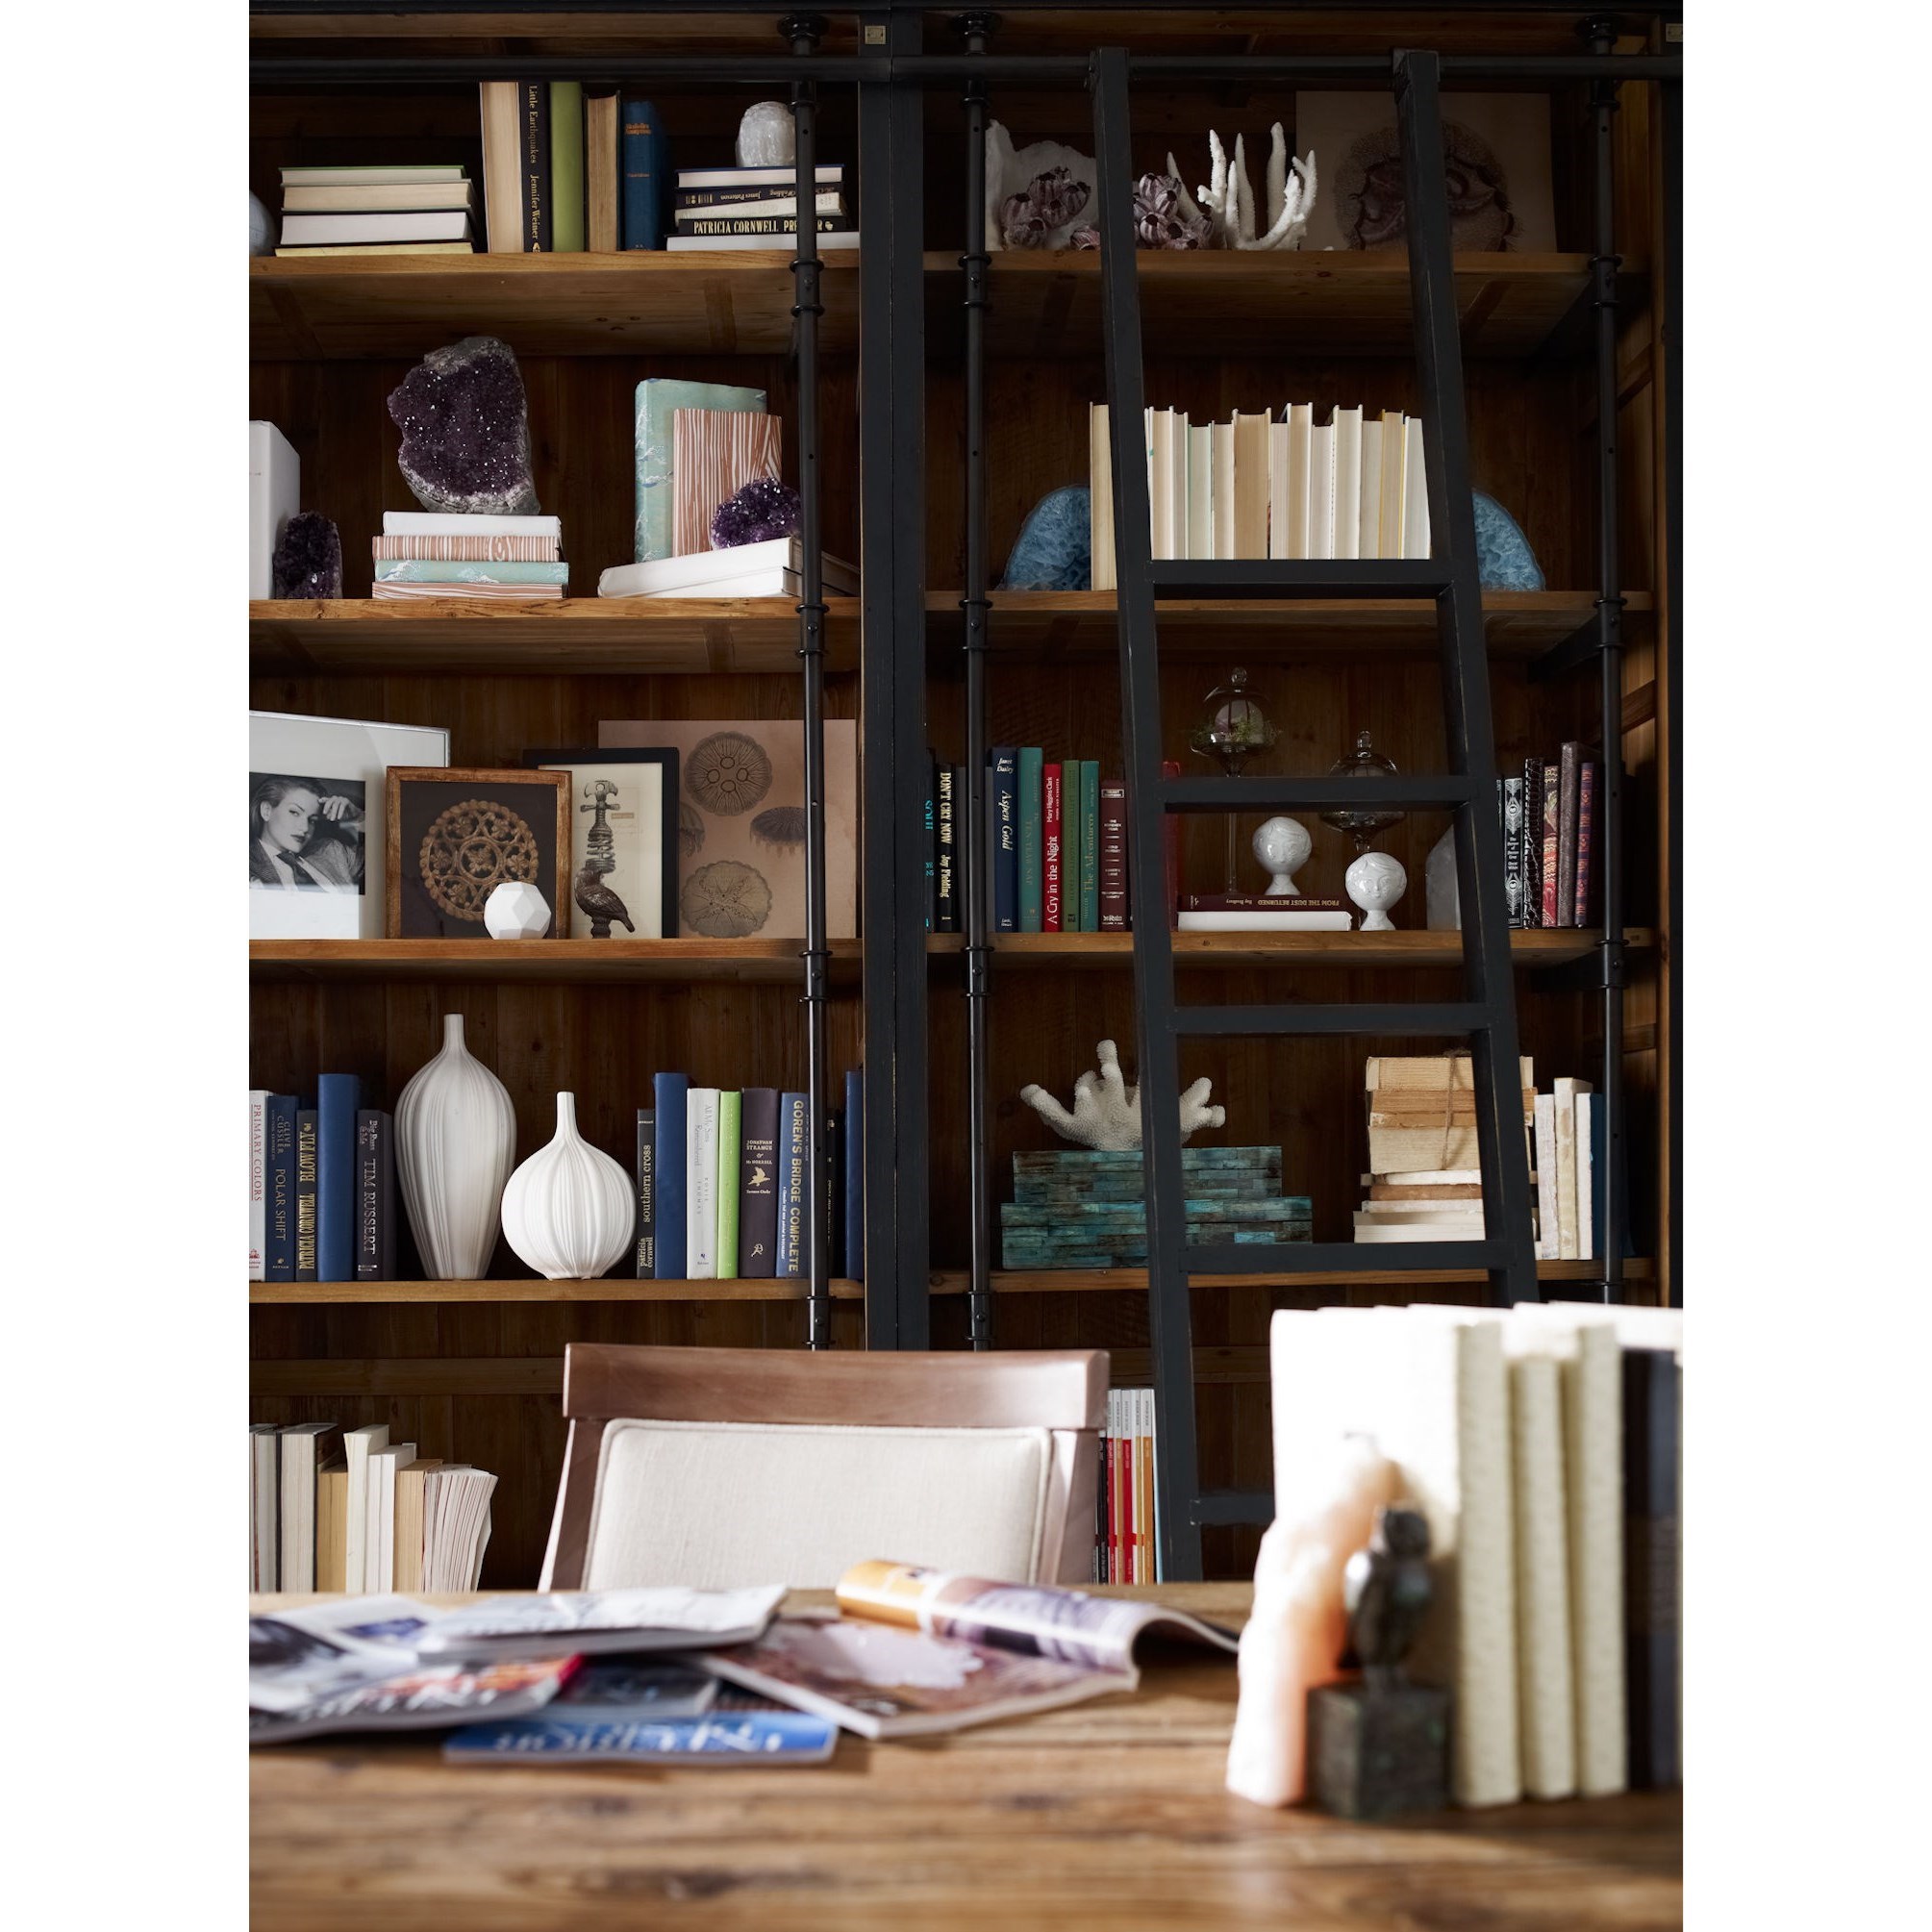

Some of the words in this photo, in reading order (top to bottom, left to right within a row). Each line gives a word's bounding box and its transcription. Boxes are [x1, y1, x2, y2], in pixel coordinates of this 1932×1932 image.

[528, 85, 539, 109] Little
[528, 111, 540, 163] Earthquakes
[530, 174, 541, 210] Jennifer
[720, 193, 745, 202] Patterson
[745, 190, 762, 200] James
[531, 210, 542, 239] Weiner
[693, 219, 732, 235] PATRICIA
[734, 219, 779, 234] CORNWELL
[940, 771, 952, 800] DON'T
[940, 801, 952, 820] CRY
[997, 790, 1014, 821] Aspen
[940, 822, 952, 844] NOW
[1001, 825, 1015, 851] Gold
[1084, 814, 1094, 870] Adventurers
[939, 854, 951, 867] Joy
[1047, 836, 1060, 863] Night
[939, 868, 952, 898] Fielding
[1047, 865, 1058, 881] the
[1083, 873, 1094, 893] The
[1047, 884, 1058, 893] in
[1046, 895, 1060, 914] Cry
[1047, 915, 1058, 925] A
[253, 1104, 263, 1155] PRIMARY
[277, 1116, 286, 1154] CUSSLER
[367, 1119, 378, 1133] Big
[703, 1115, 713, 1126] My
[791, 1100, 804, 1154] GOREN'S
[299, 1131, 315, 1152] FLY
[369, 1133, 378, 1151] Russ
[693, 1124, 703, 1167] Remembered
[299, 1152, 315, 1183] BLOW
[642, 1144, 652, 1172] cross
[253, 1158, 263, 1201] COLORS
[275, 1168, 287, 1206] POLAR
[364, 1158, 376, 1188] TIM
[790, 1158, 802, 1203] BRIDGE
[298, 1192, 315, 1234] CORNWELL
[640, 1174, 652, 1223] southern
[275, 1210, 287, 1241] SHIFT
[364, 1192, 376, 1255] RUSSERT
[298, 1235, 315, 1269] PATRICIA
[645, 1237, 654, 1267] cornwell
[789, 1207, 800, 1272] COMPLETE
